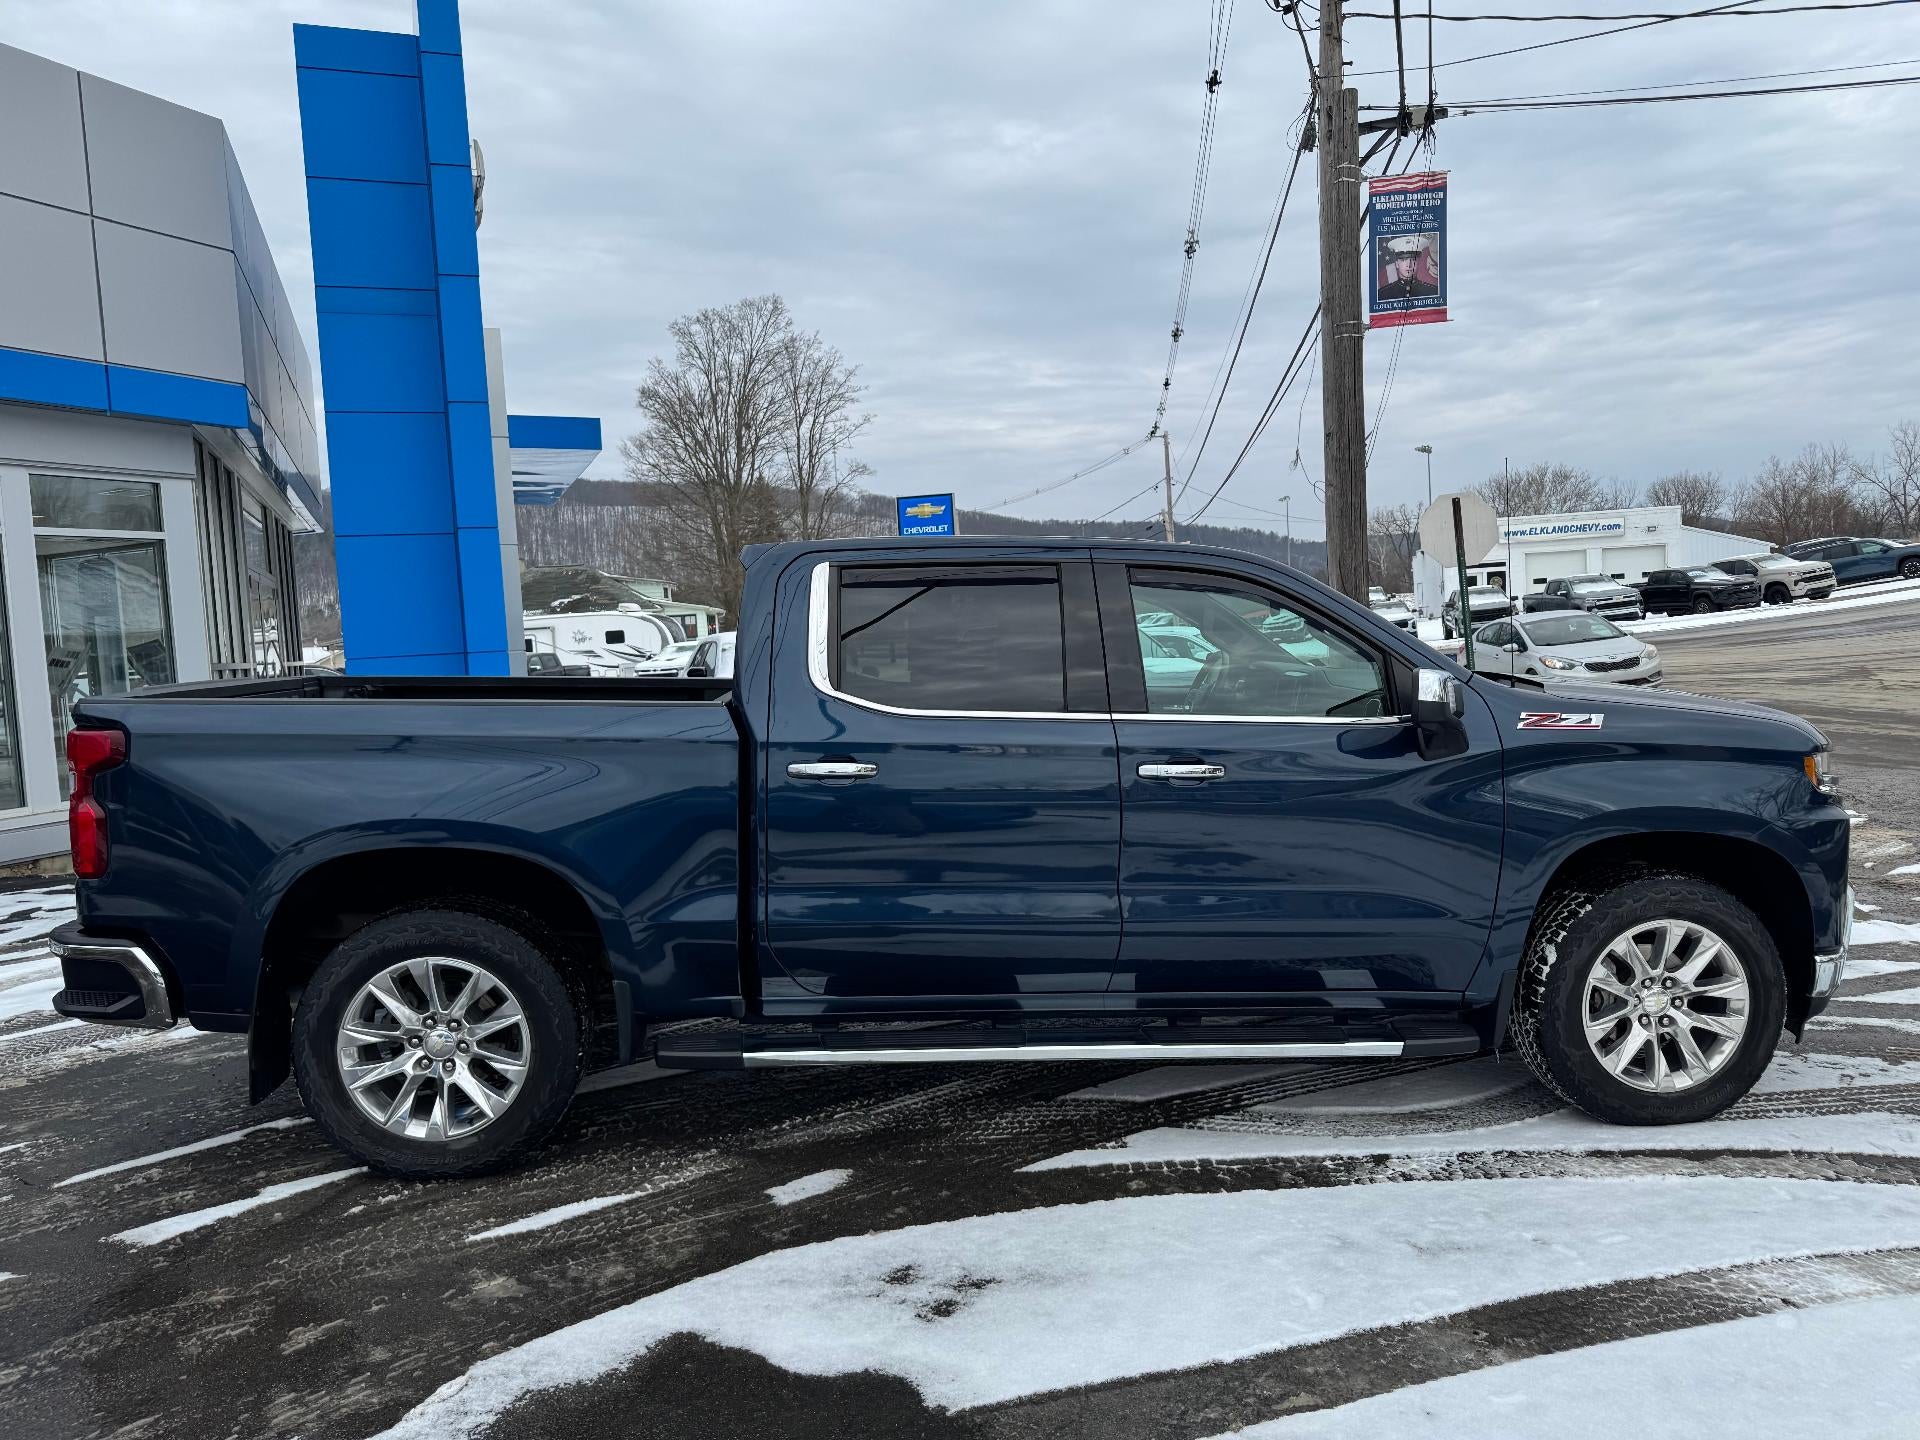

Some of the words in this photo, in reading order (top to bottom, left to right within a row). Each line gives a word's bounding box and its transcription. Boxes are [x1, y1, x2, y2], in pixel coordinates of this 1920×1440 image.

[1372, 195, 1404, 204] ELKLAND
[1406, 191, 1444, 200] BOROUGH
[1375, 200, 1418, 210] HOMETOWN
[1420, 198, 1441, 207] HERO
[903, 524, 949, 535] CHEVROLET
[1503, 522, 1622, 538] www.ELKLANDCHEVY.com
[1517, 711, 1605, 730] Z71
